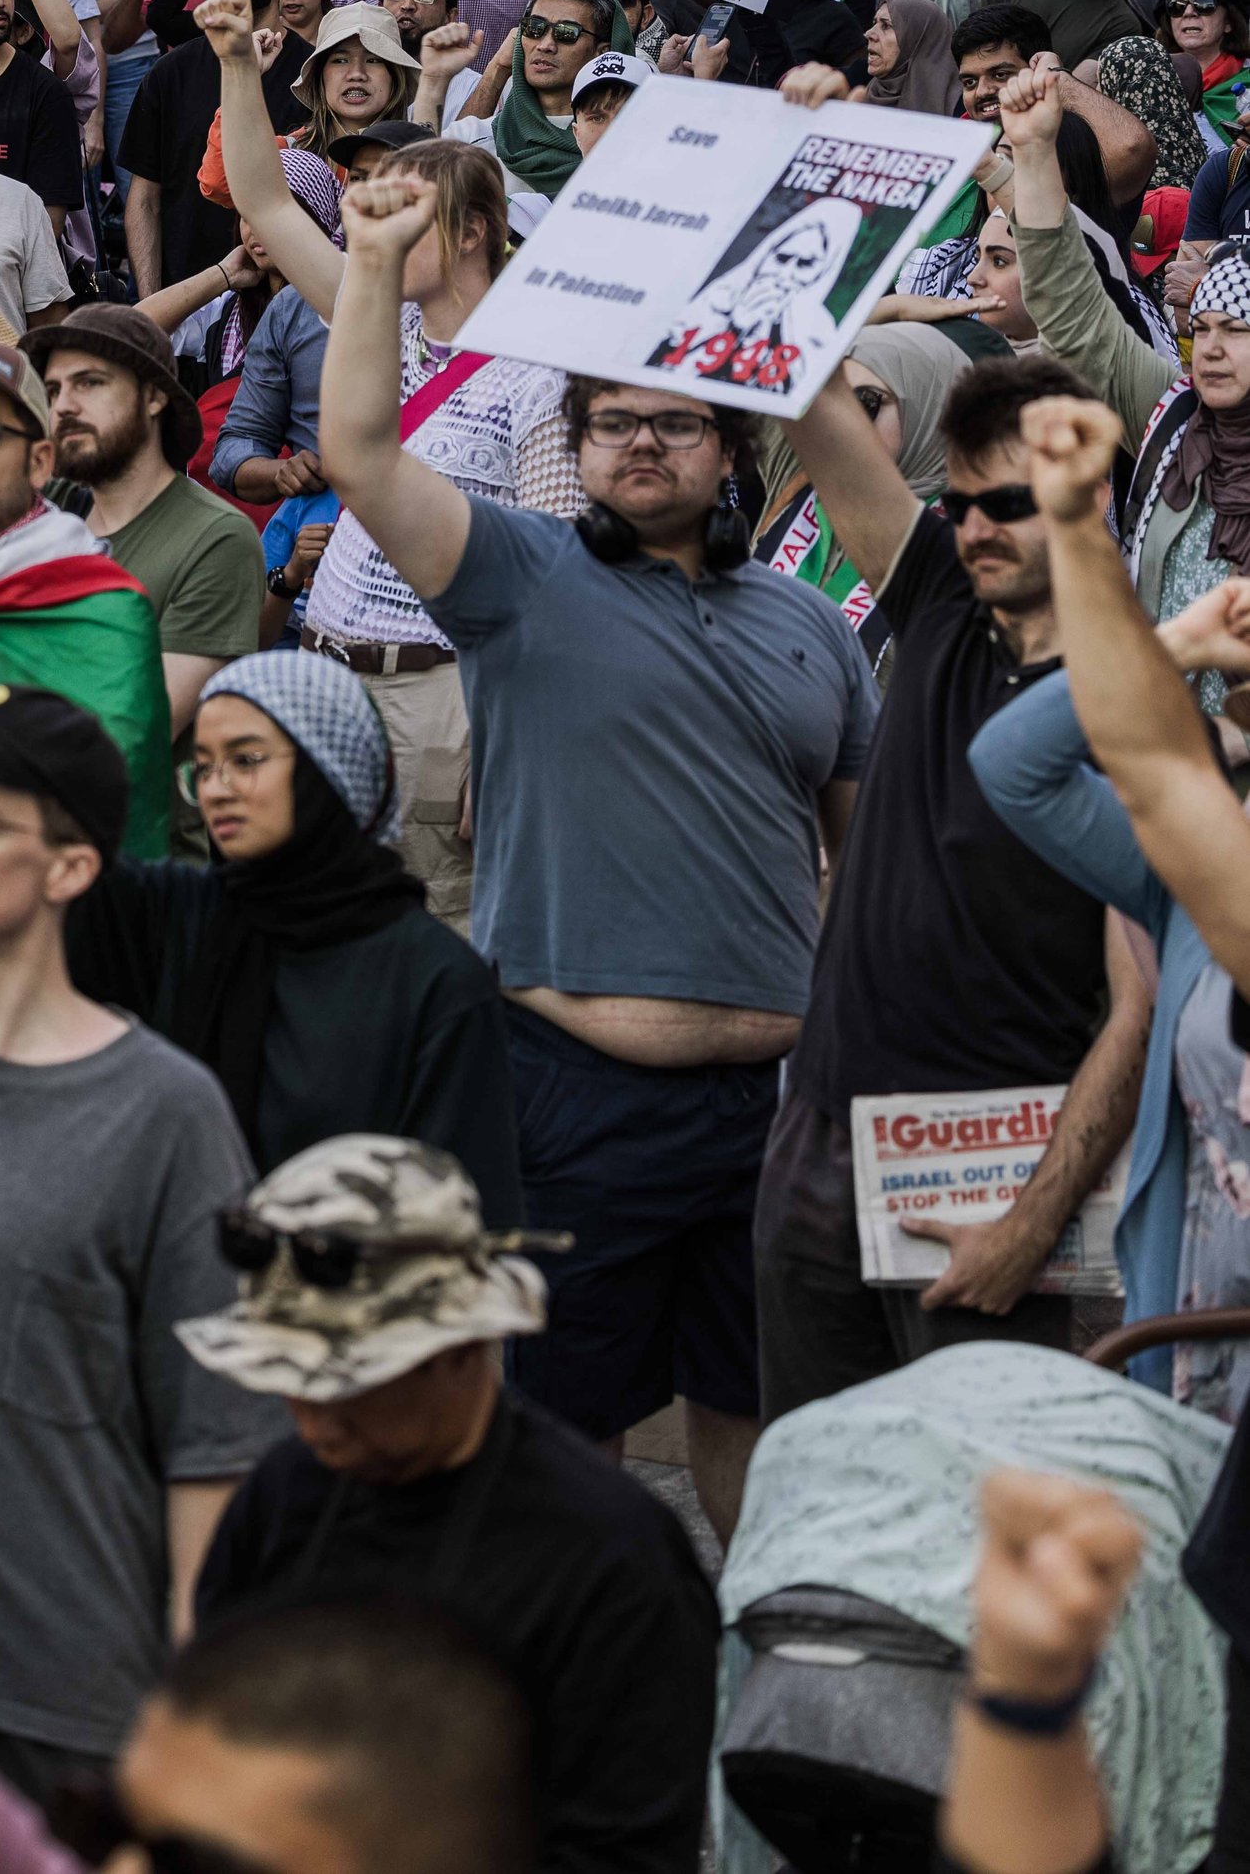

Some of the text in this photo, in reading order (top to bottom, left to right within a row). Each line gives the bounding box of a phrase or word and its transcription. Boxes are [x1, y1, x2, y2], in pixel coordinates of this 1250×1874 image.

[668, 125, 719, 149] Save
[796, 136, 953, 185] REMEMBER
[782, 161, 928, 211] THE NAKBA
[572, 190, 710, 232] Sheikh Jarrah
[548, 270, 646, 306] Palestine
[661, 327, 801, 386] 1948
[881, 1168, 960, 1193] ISRAEL
[962, 1165, 1005, 1184] OUT
[886, 1191, 942, 1213] STOP
[949, 1186, 990, 1206] THE
